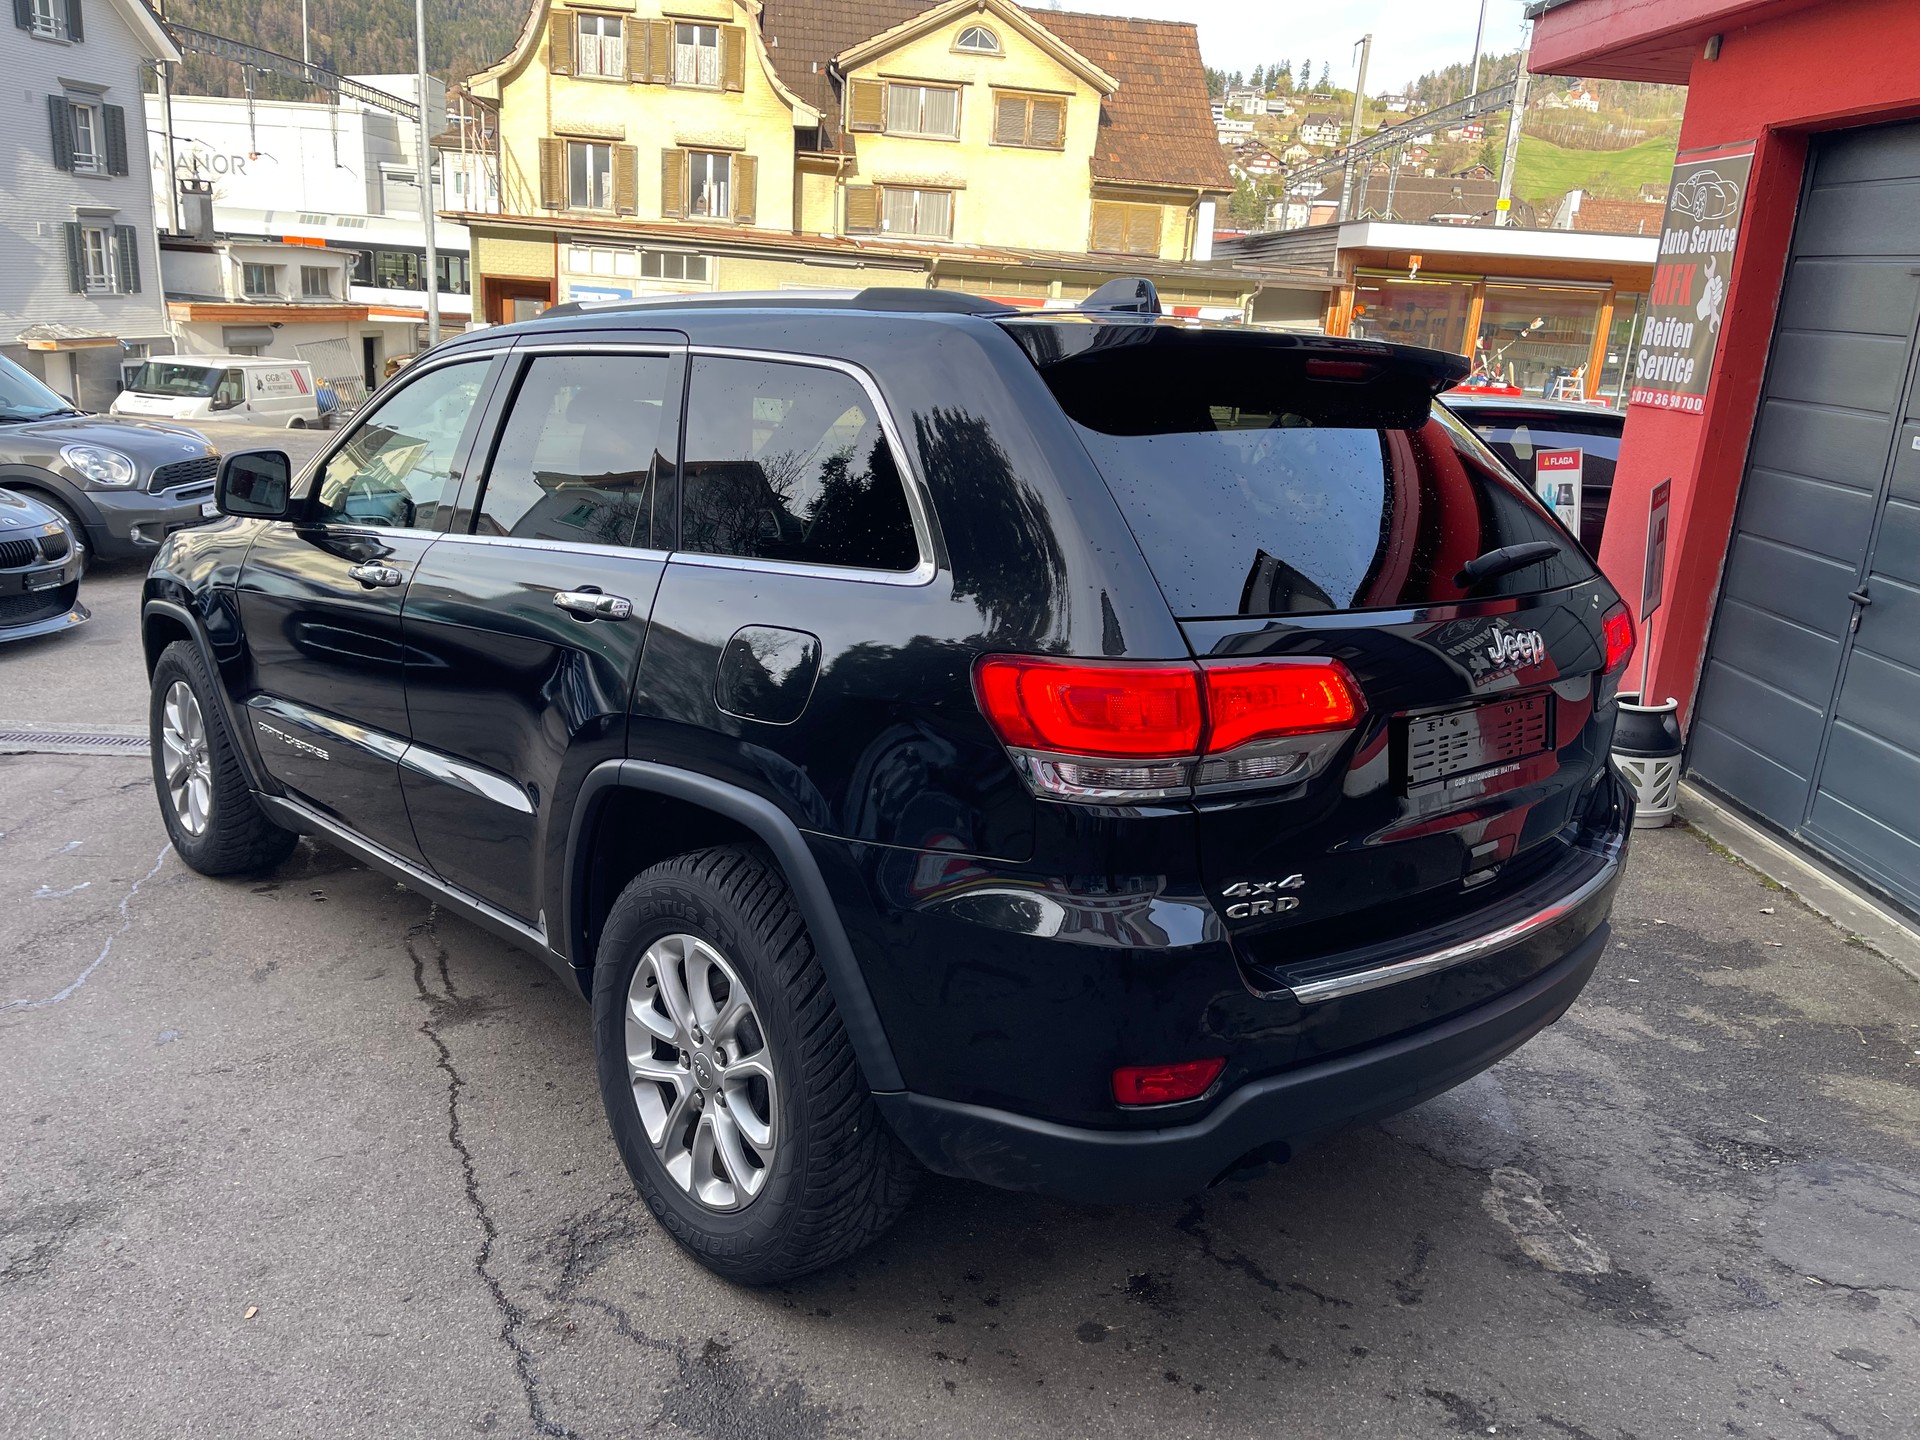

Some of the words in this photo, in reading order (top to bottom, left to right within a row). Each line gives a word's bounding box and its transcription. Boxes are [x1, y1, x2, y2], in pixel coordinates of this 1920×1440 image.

[152, 150, 247, 176] MANOR
[1660, 228, 1689, 255] Auto
[1690, 224, 1735, 254] Service
[1651, 263, 1697, 306] MFK
[1641, 315, 1693, 349] Reifen
[265, 373, 280, 382] GGB
[1636, 349, 1694, 384] Service
[1681, 397, 1703, 411] 700
[1550, 457, 1573, 466] FLAGA
[1487, 626, 1545, 665] Jeep
[1454, 778, 1466, 787] GGB
[1467, 767, 1499, 784] AUTOMOBILE
[1222, 874, 1305, 897] 4x4
[1225, 896, 1300, 919] CRD
